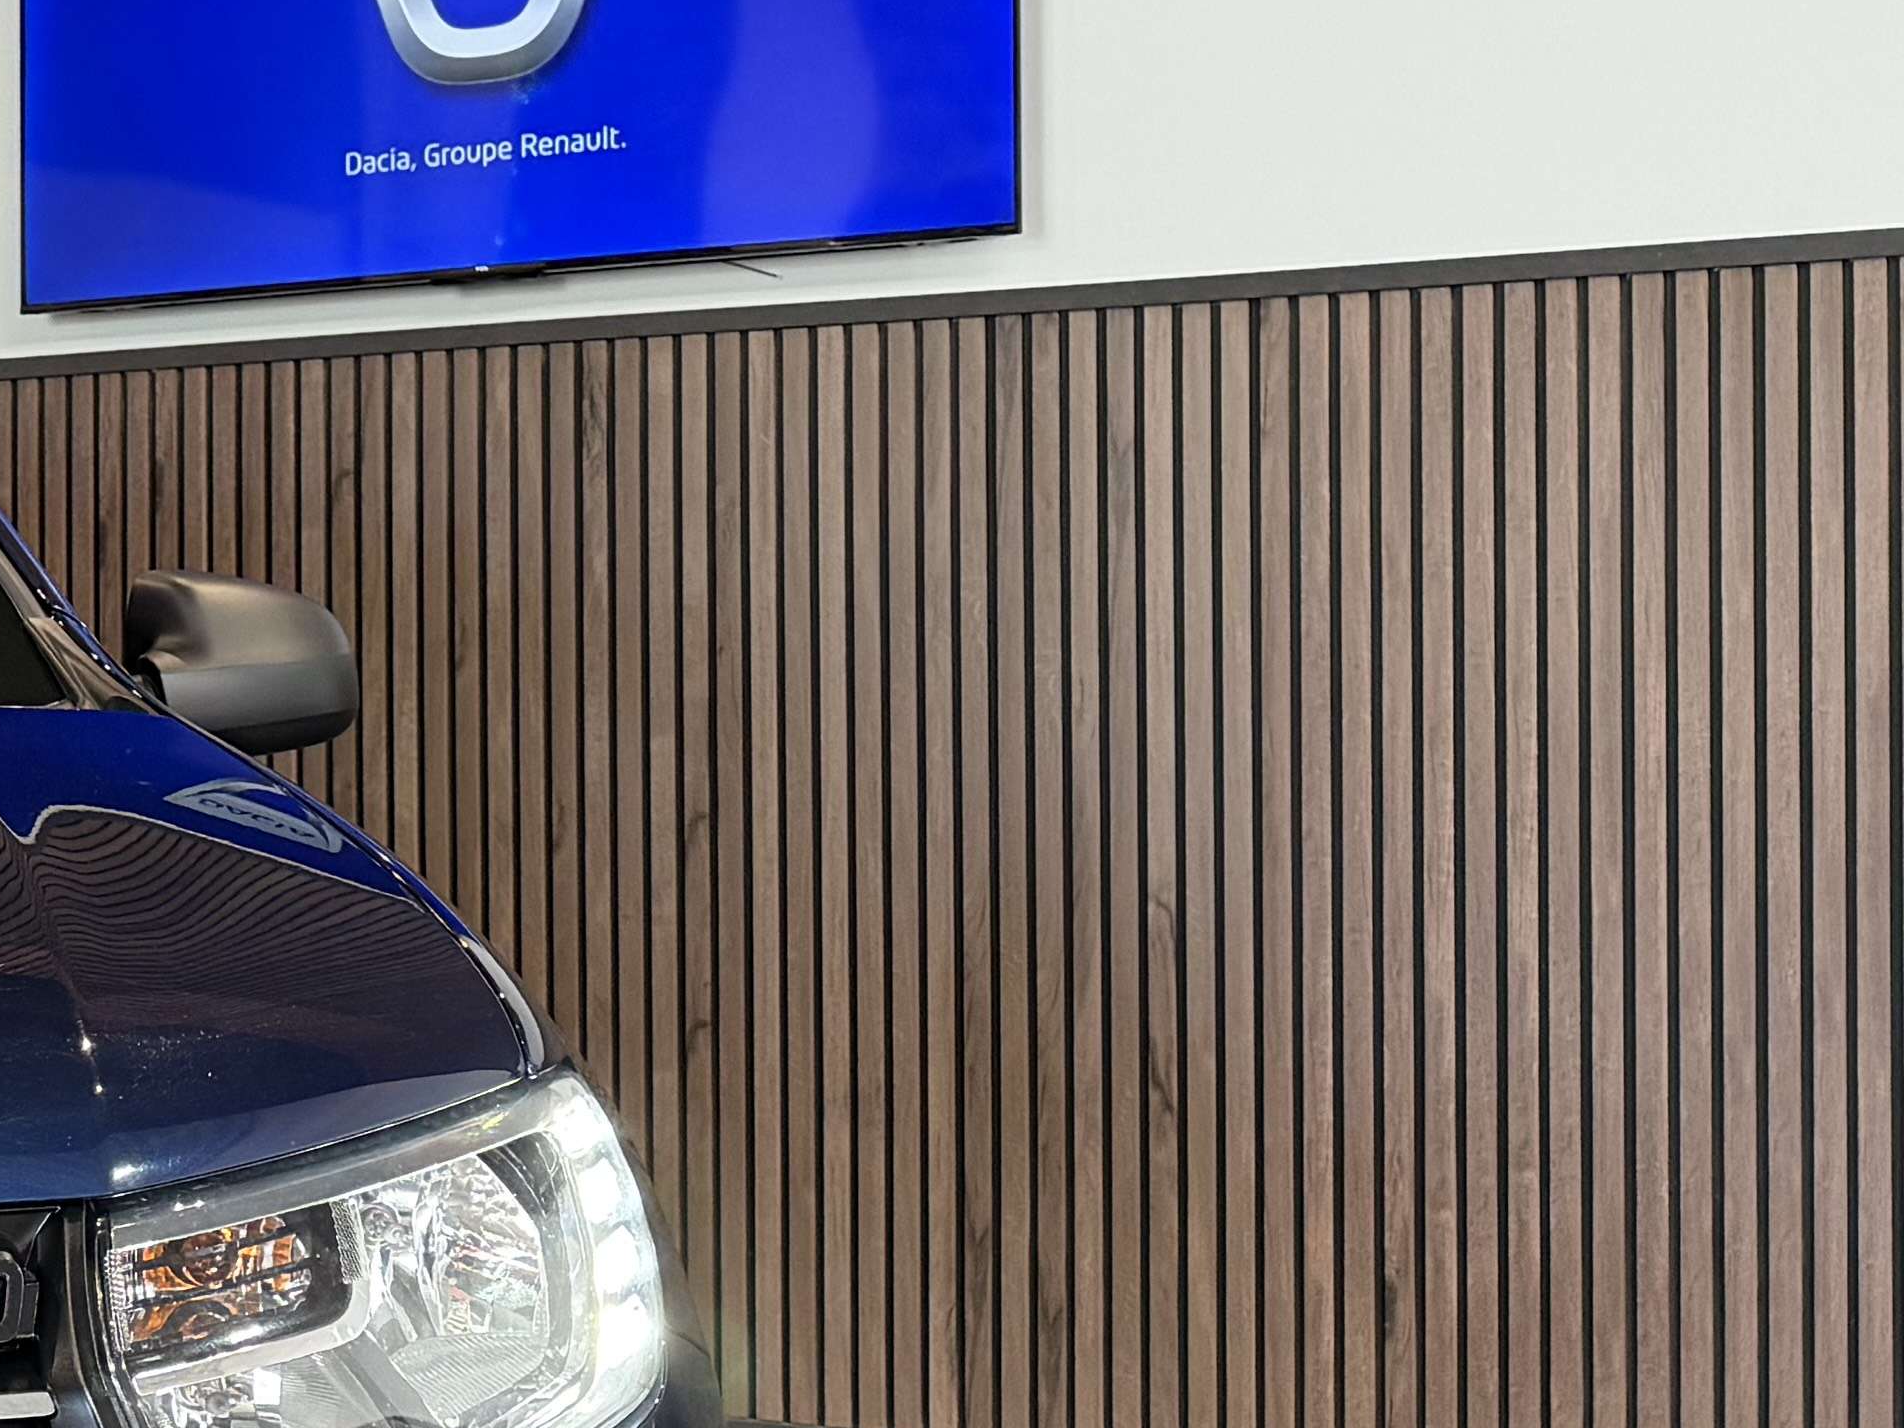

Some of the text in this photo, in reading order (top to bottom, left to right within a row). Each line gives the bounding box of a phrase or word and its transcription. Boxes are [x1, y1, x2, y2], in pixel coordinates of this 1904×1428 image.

[345, 125, 627, 176] Dacia, Groupe Renault.
